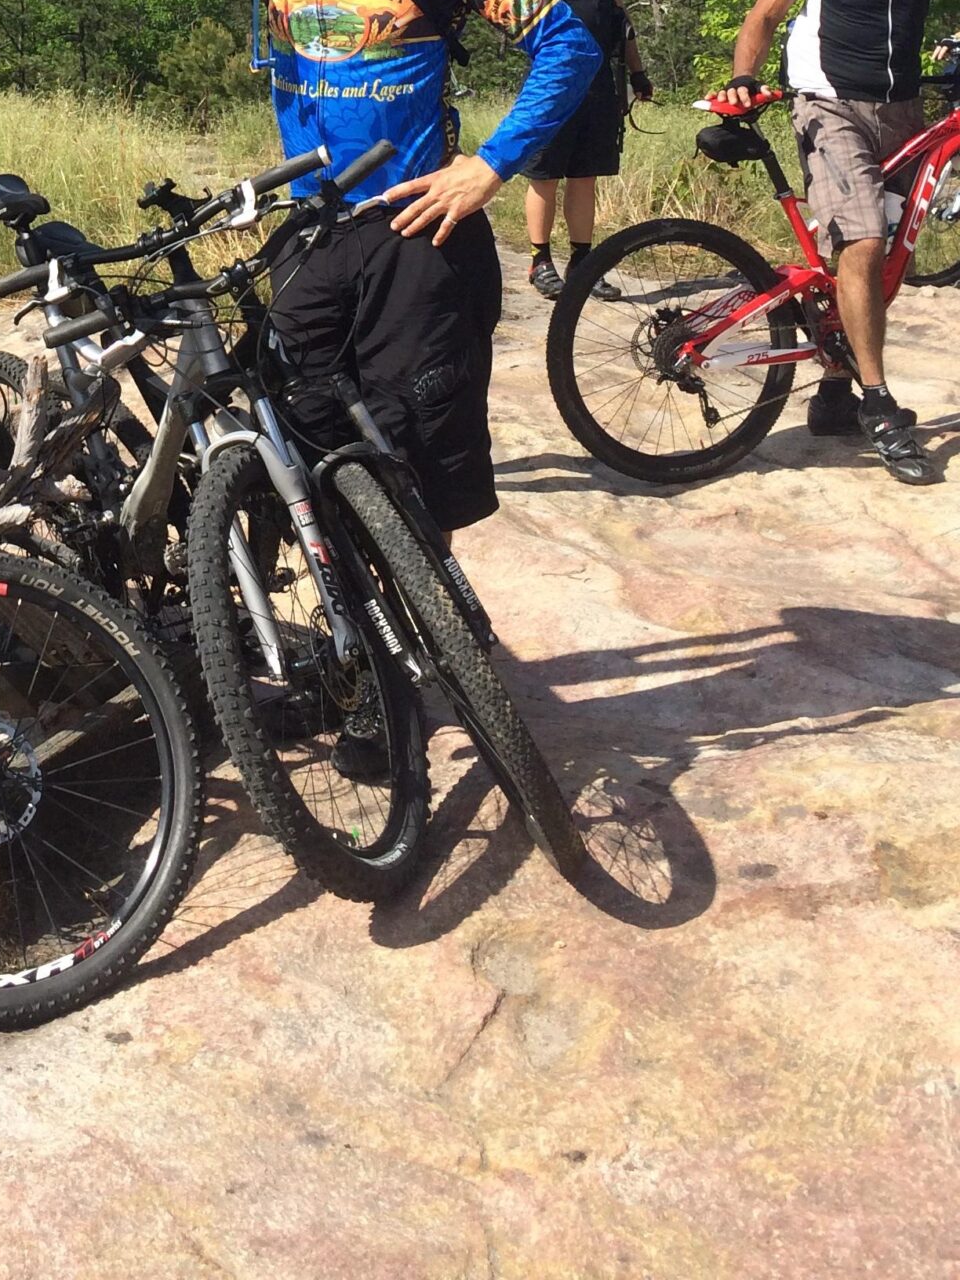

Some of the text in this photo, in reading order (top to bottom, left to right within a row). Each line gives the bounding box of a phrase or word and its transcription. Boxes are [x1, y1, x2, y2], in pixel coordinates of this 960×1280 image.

[308, 78, 339, 98] Ales
[341, 81, 368, 99] and
[369, 78, 414, 102] Lagers
[19, 573, 65, 598] RON
[443, 555, 480, 613] ROCKSHOX
[70, 596, 141, 657] ROCKET
[363, 598, 403, 655] ROCKSHOX
